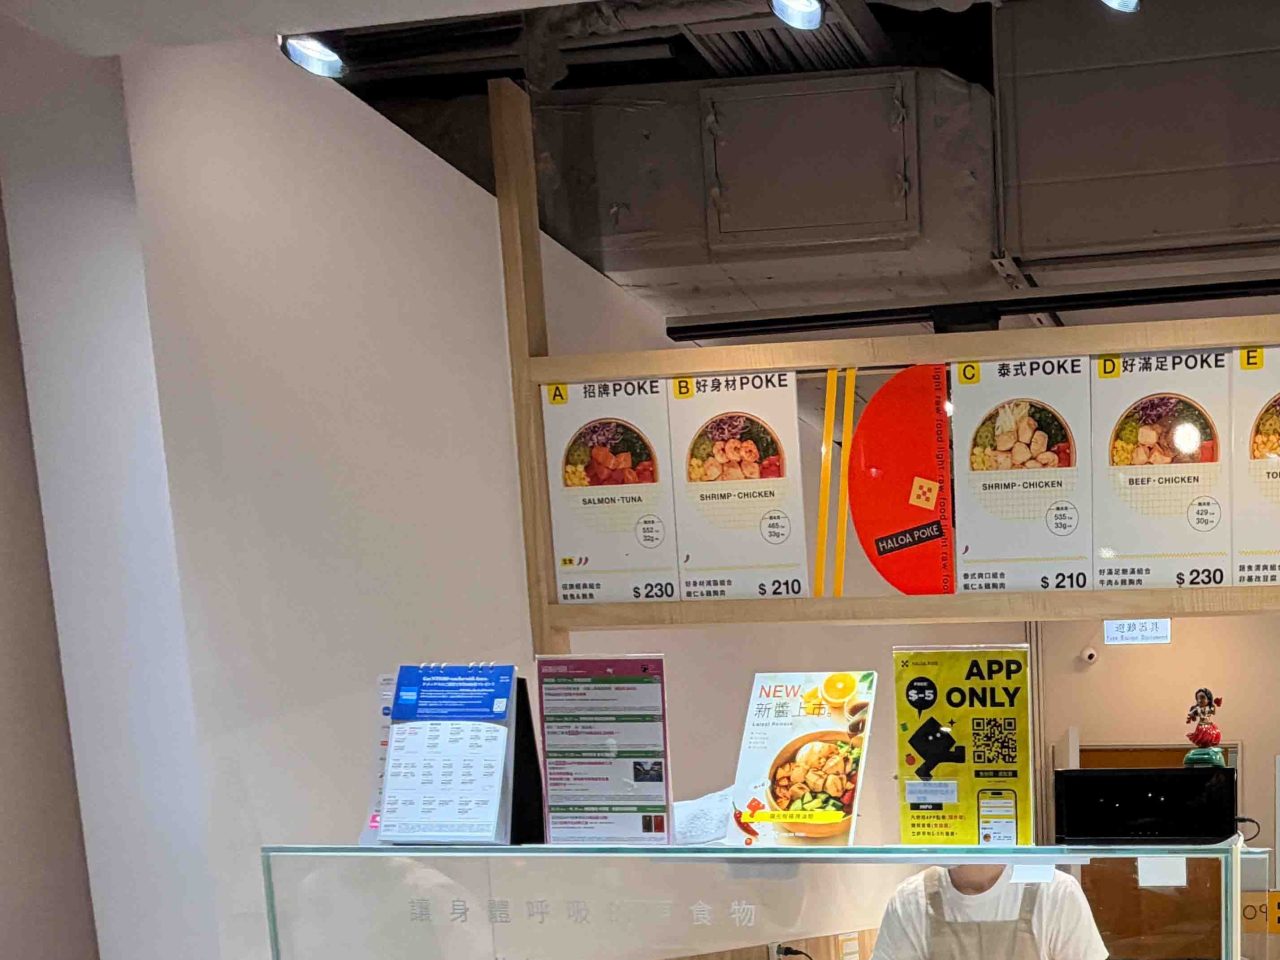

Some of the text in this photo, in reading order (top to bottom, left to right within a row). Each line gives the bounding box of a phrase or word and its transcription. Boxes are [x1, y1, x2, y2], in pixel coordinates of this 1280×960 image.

[1246, 349, 1258, 366] E
[963, 365, 975, 380] C
[1103, 359, 1116, 374] D
[552, 386, 564, 401] A
[678, 380, 690, 395] B
[914, 524, 940, 542] POKE
[878, 532, 913, 552] HALOA
[1055, 572, 1087, 589] 210
[1189, 568, 1224, 585] 230
[644, 582, 675, 599] 230
[772, 579, 802, 596] 210
[965, 659, 1023, 681] APP
[759, 685, 801, 698] NEW
[945, 686, 1022, 708] ONLY
